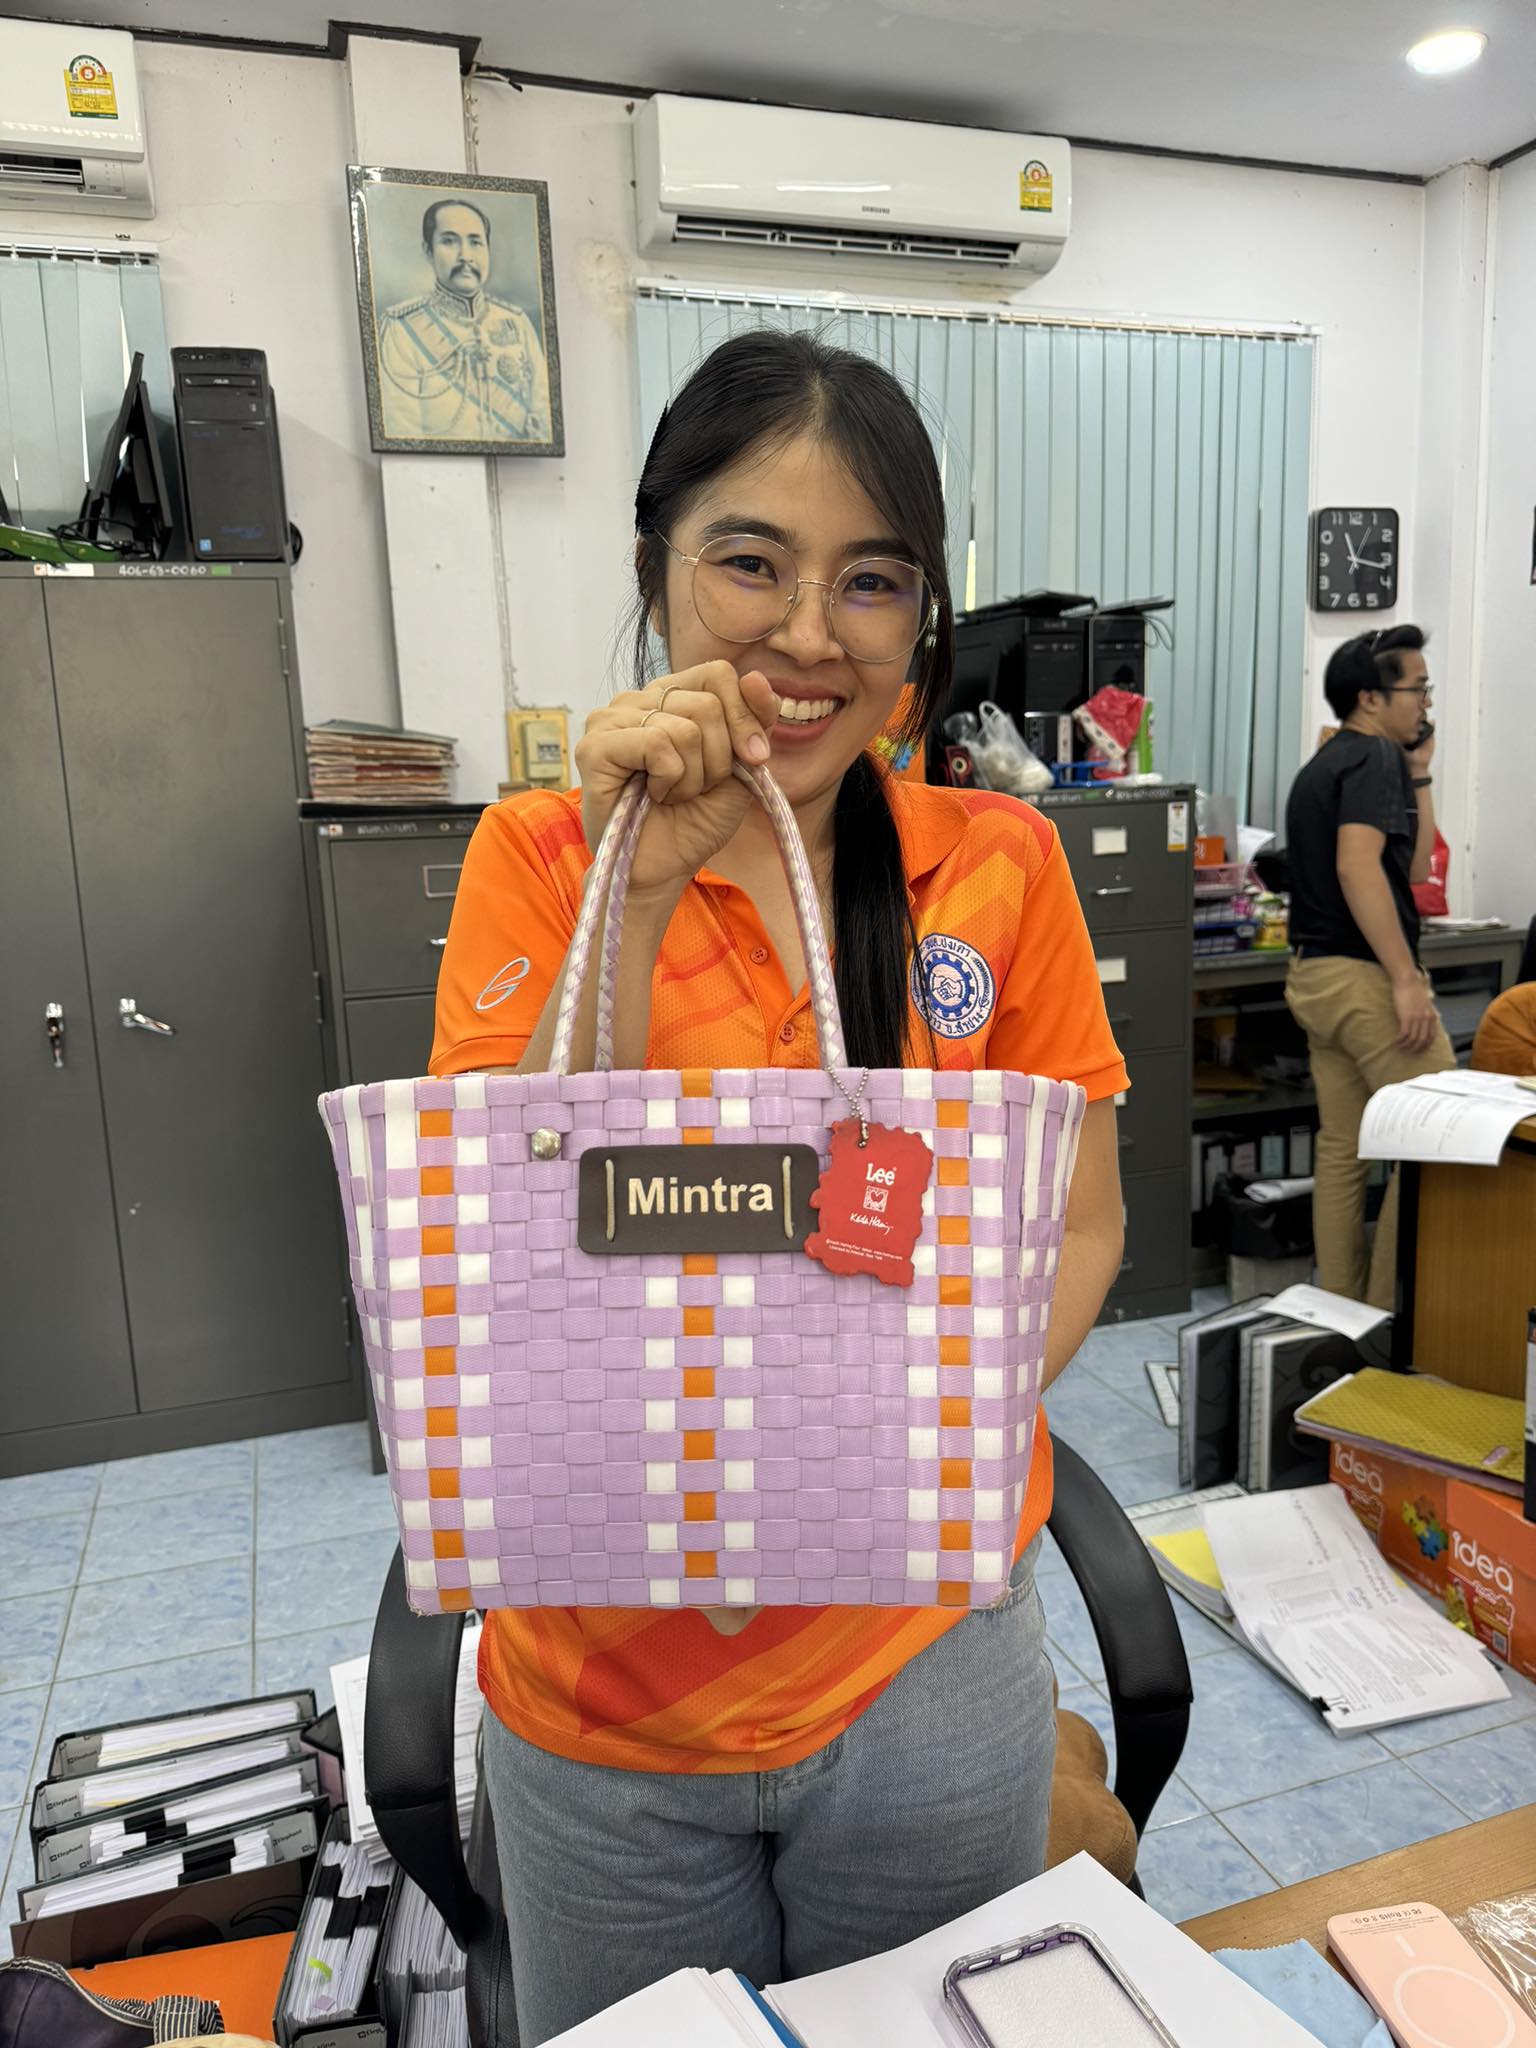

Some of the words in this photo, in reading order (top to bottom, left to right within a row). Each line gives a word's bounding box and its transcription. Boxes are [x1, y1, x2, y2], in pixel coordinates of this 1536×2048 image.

[1331, 511, 1343, 525] 11
[1349, 511, 1363, 525] 12
[1371, 511, 1378, 525] 1
[1381, 528, 1393, 543] 2
[1380, 551, 1393, 568] 3
[1380, 576, 1391, 590] 4
[1330, 592, 1341, 608] 7
[1347, 592, 1361, 607] 6
[1366, 592, 1379, 607] 5
[866, 1162, 895, 1185] Lee
[628, 1177, 774, 1215] Mintra
[1334, 1441, 1384, 1496] idea
[1453, 1531, 1514, 1594] idea
[52, 1795, 78, 1808] Elephant
[57, 1843, 83, 1858] Elephant
